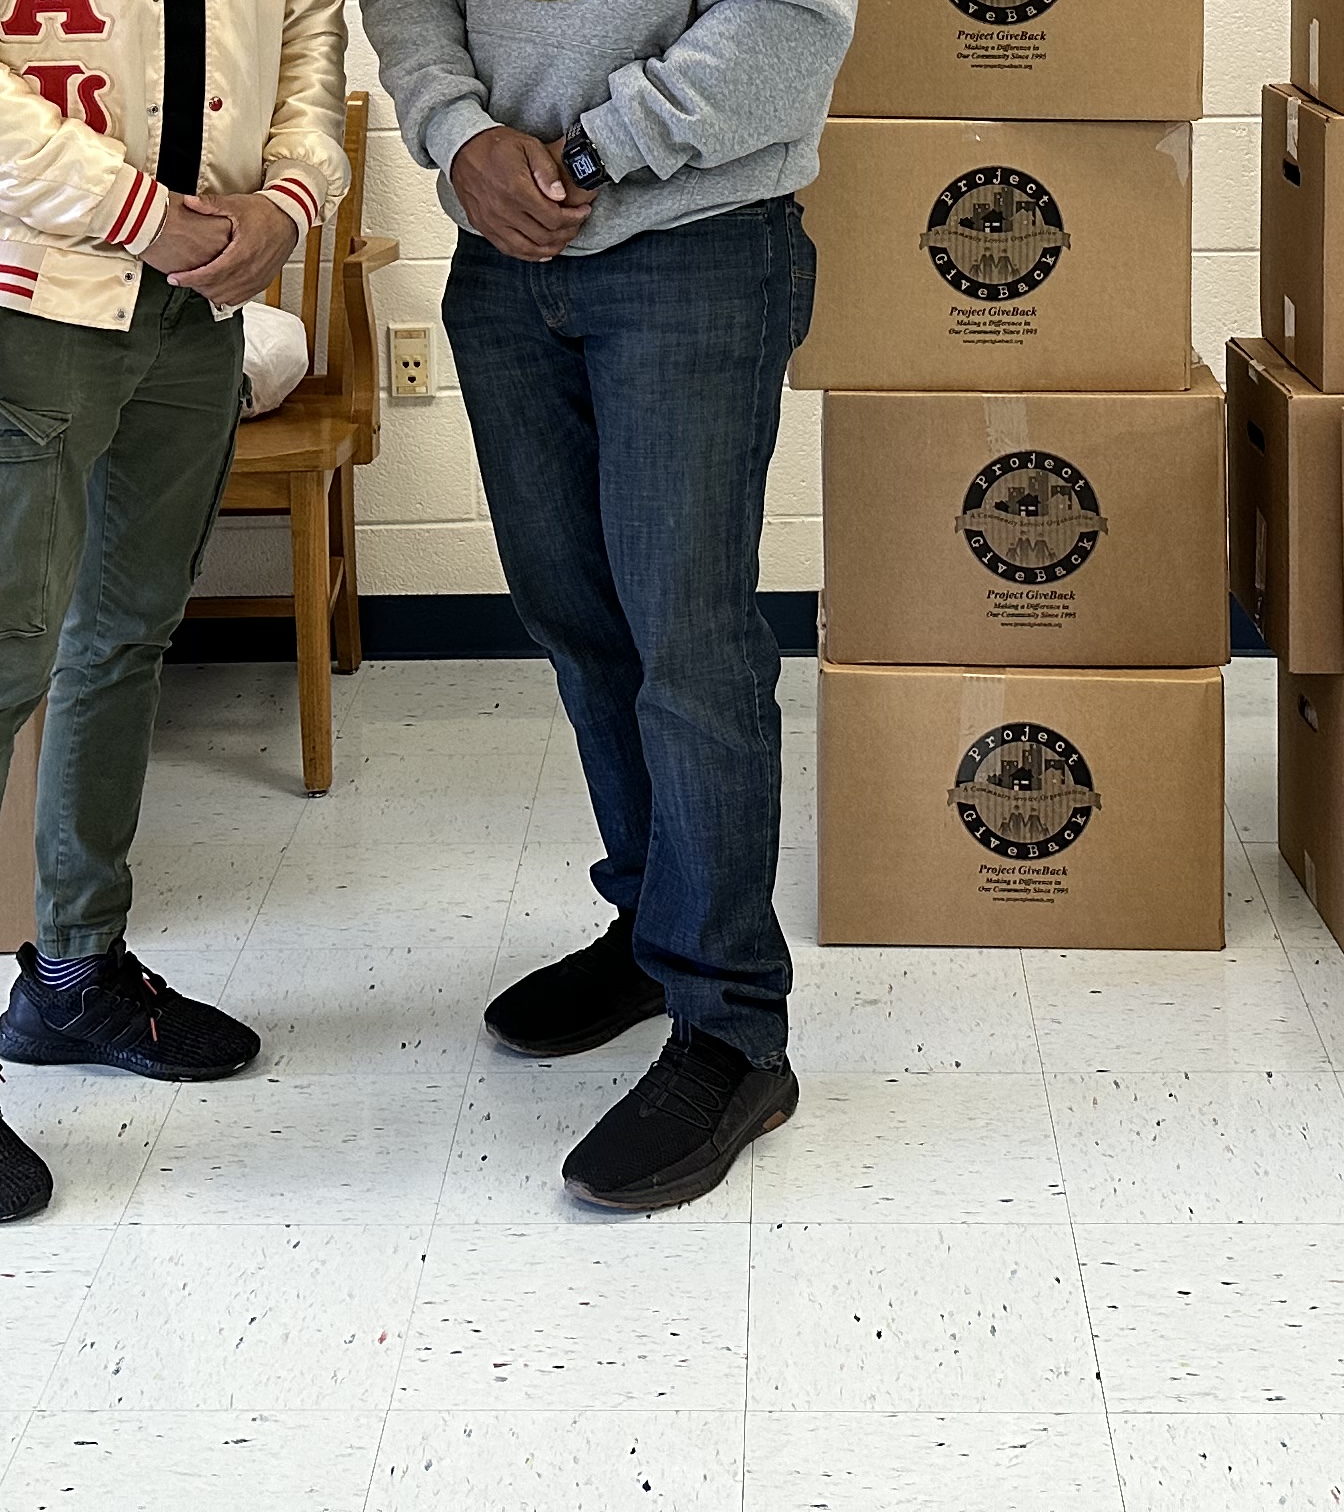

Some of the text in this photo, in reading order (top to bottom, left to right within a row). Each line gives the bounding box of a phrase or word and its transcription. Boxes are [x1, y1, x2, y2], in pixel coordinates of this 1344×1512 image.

[955, 30, 1046, 43] Project GiveBack
[940, 168, 1051, 206] Project
[935, 253, 1056, 298] GiveBack
[974, 452, 1087, 491] Project
[971, 536, 1094, 582] GiveBack
[985, 589, 1076, 602] Project GiveBack
[968, 725, 1080, 765] Project
[963, 810, 1087, 857] GiveBack
